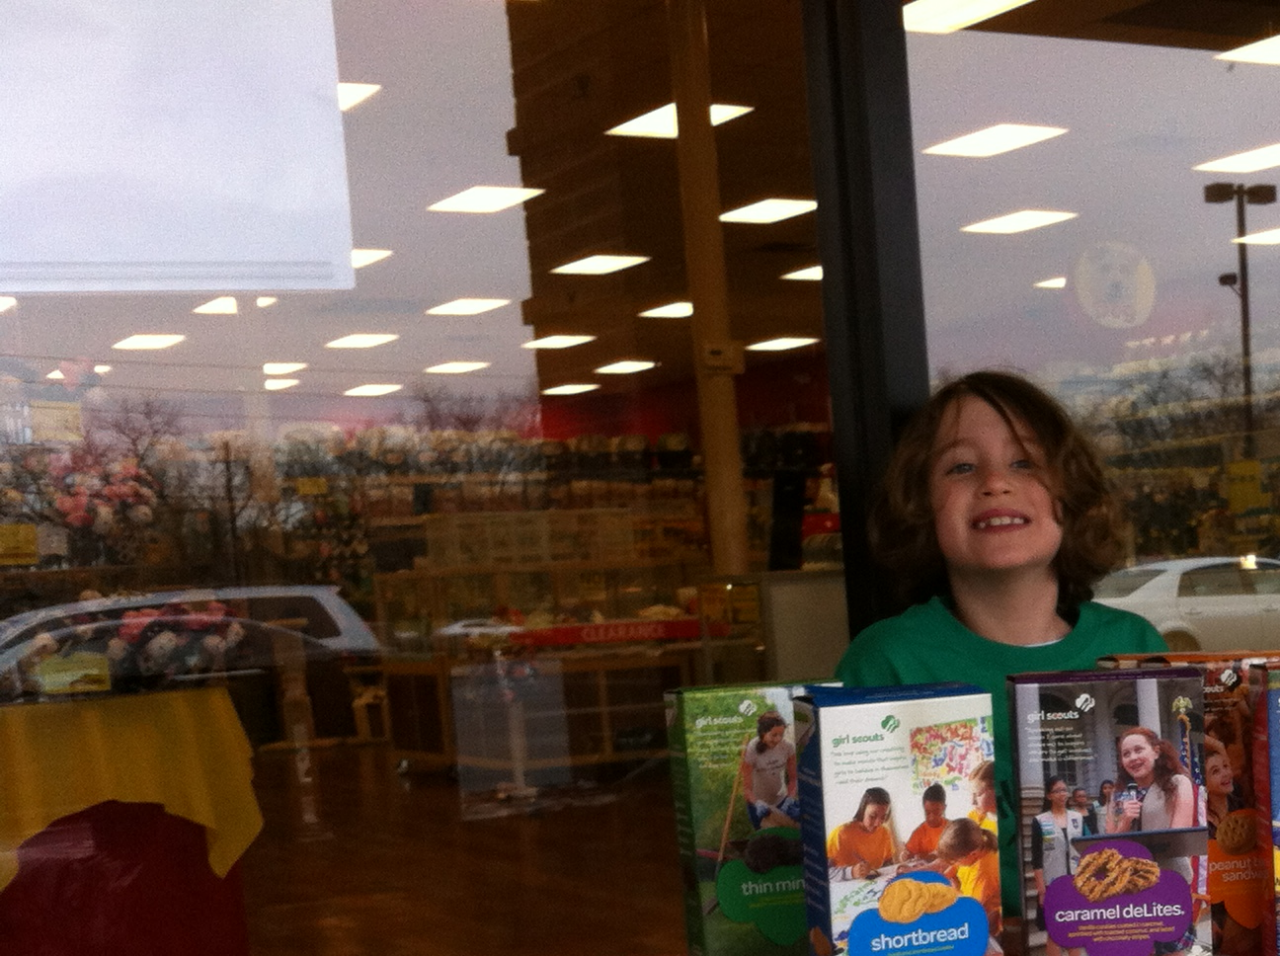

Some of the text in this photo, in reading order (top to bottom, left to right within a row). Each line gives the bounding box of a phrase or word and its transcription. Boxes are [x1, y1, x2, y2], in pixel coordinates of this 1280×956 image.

[1027, 710, 1079, 723] girl scouts
[832, 733, 884, 747] girl scouts
[741, 879, 773, 895] thin
[1055, 904, 1120, 922] caramel
[871, 922, 969, 952] shortbread
